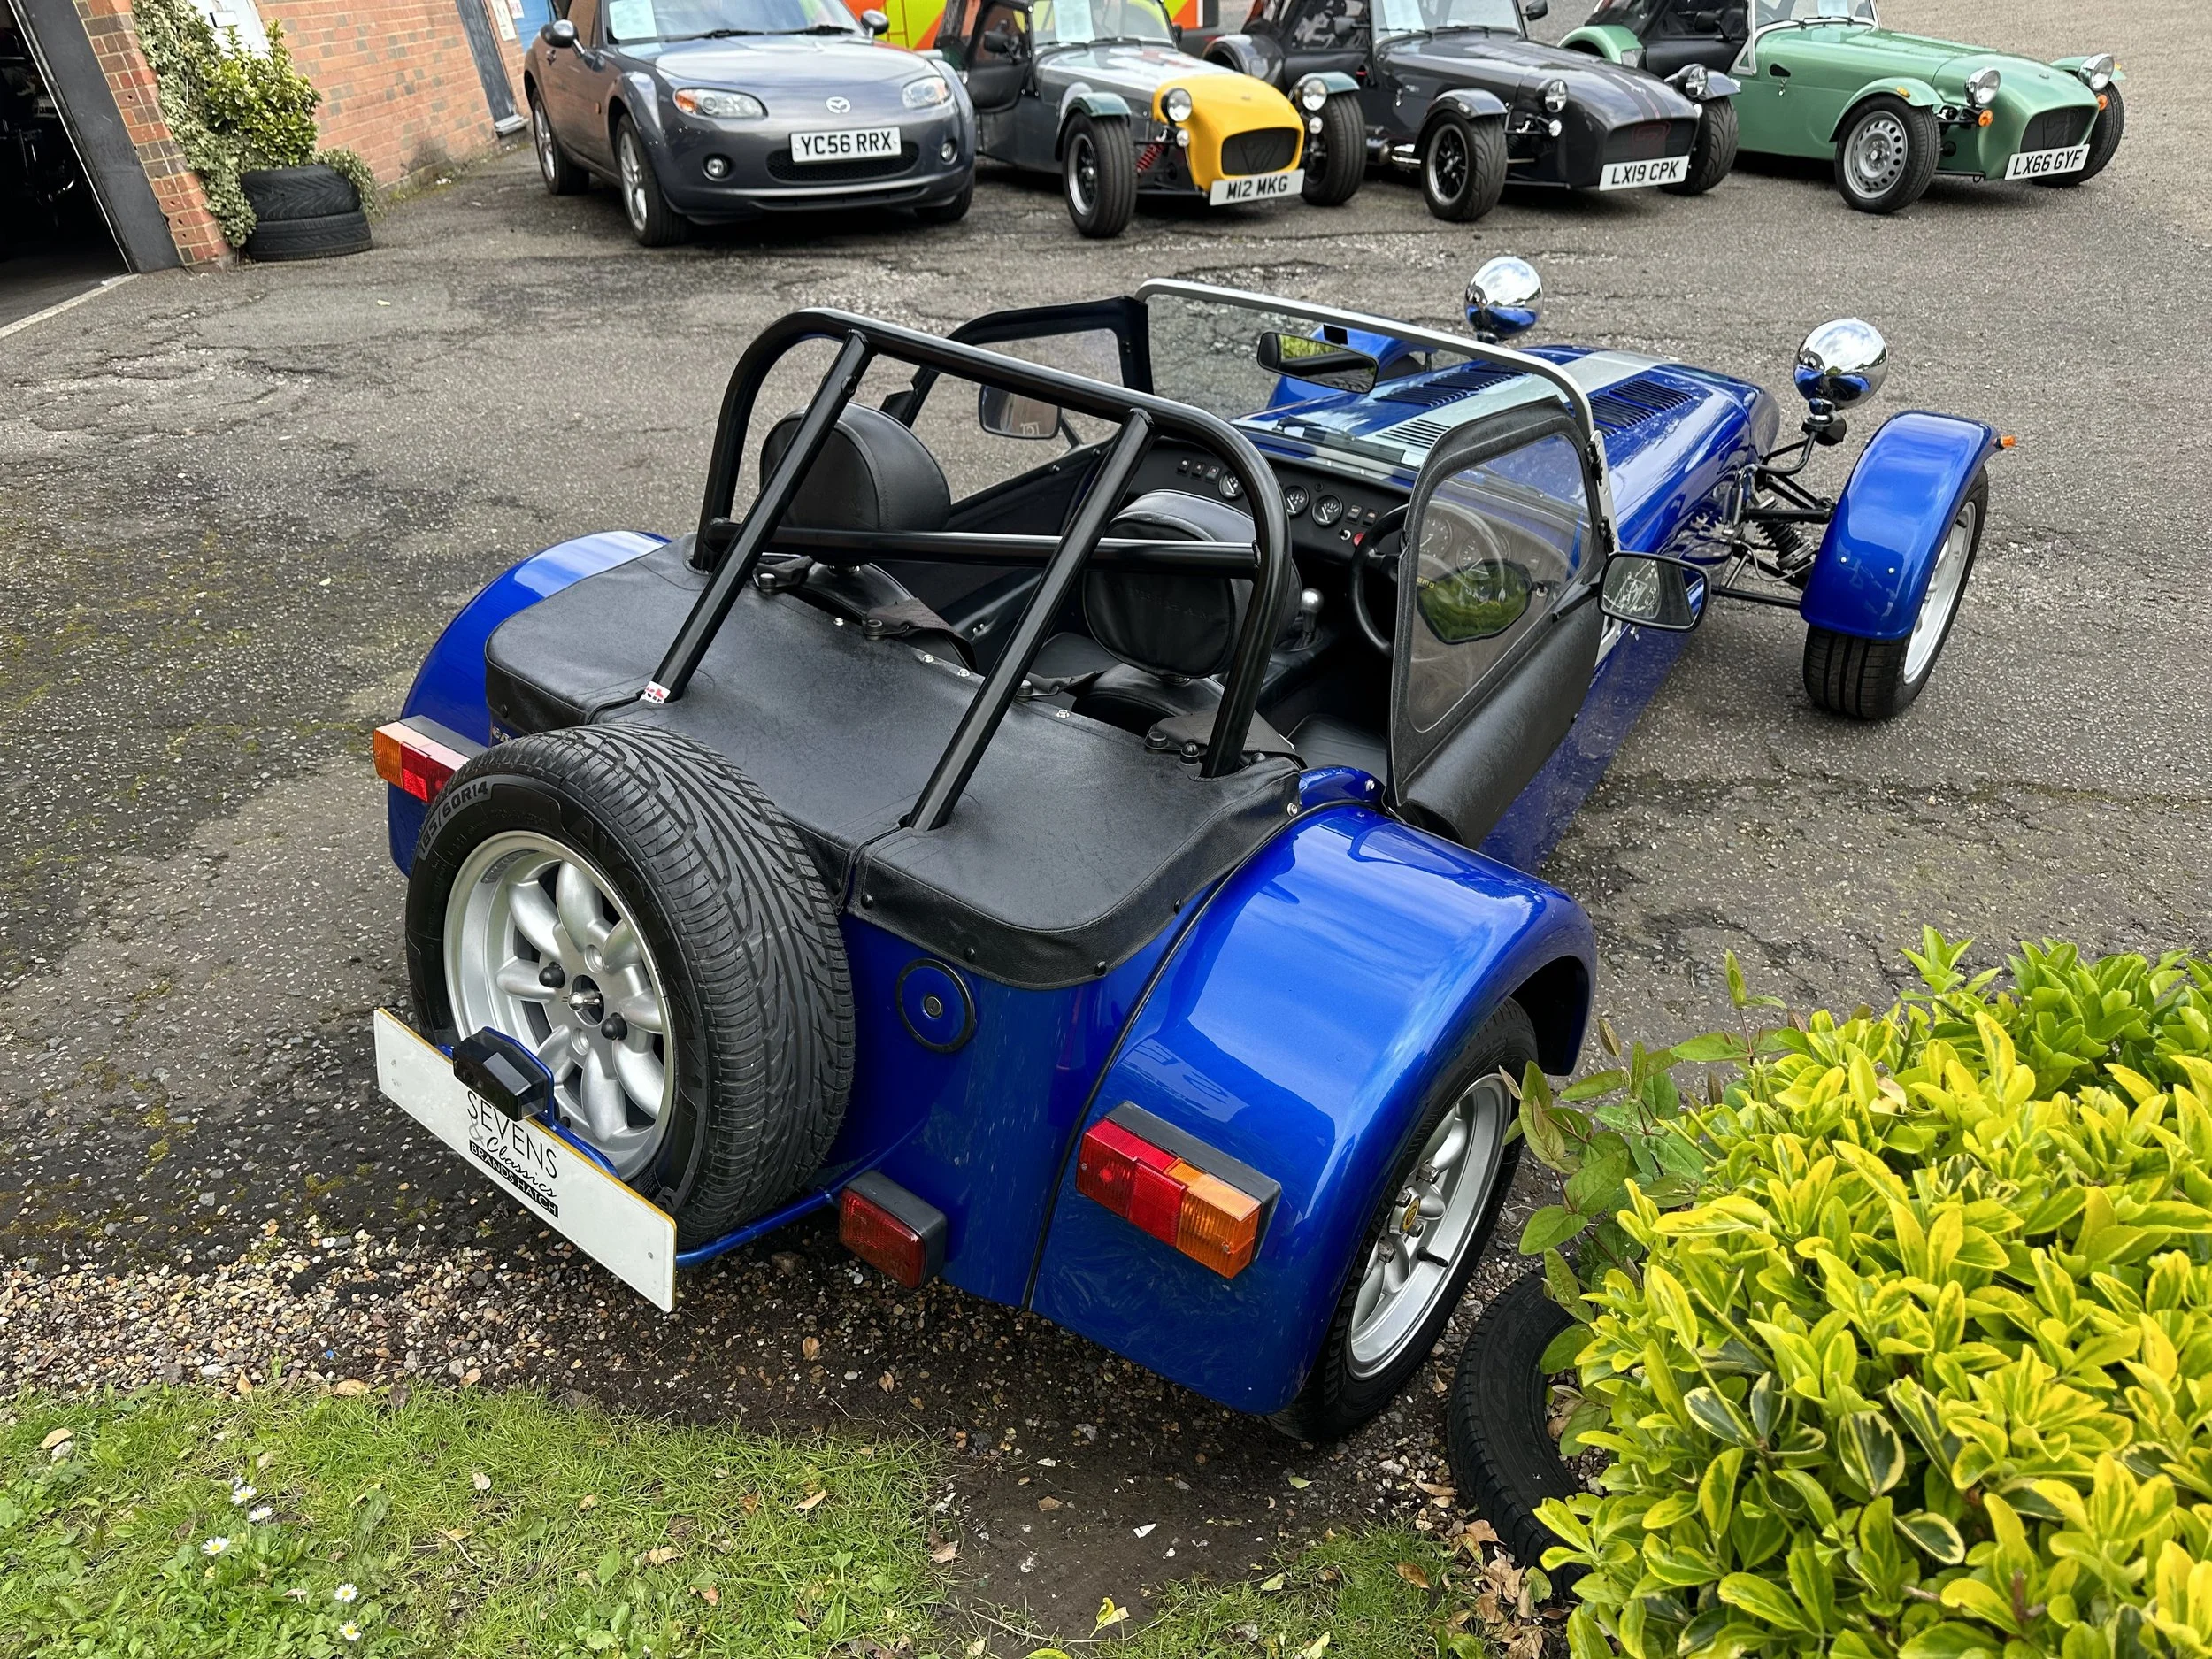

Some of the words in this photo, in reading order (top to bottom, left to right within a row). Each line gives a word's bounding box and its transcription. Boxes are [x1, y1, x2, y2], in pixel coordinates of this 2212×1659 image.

[801, 134, 851, 157] YC56
[856, 130, 892, 153] RRX
[2012, 153, 2053, 177] LX66
[2054, 149, 2084, 171] GYF
[1226, 180, 1253, 200] M12
[1256, 175, 1288, 196] MKG
[1611, 164, 1647, 185] LX19
[1649, 159, 1679, 180] CPK
[420, 780, 489, 853] 185/60R14
[467, 1090, 557, 1179] SEVENS
[468, 1118, 485, 1148] &
[486, 1136, 557, 1198] Classics
[472, 1144, 515, 1184] BRANDS
[518, 1181, 557, 1216] HATCH
